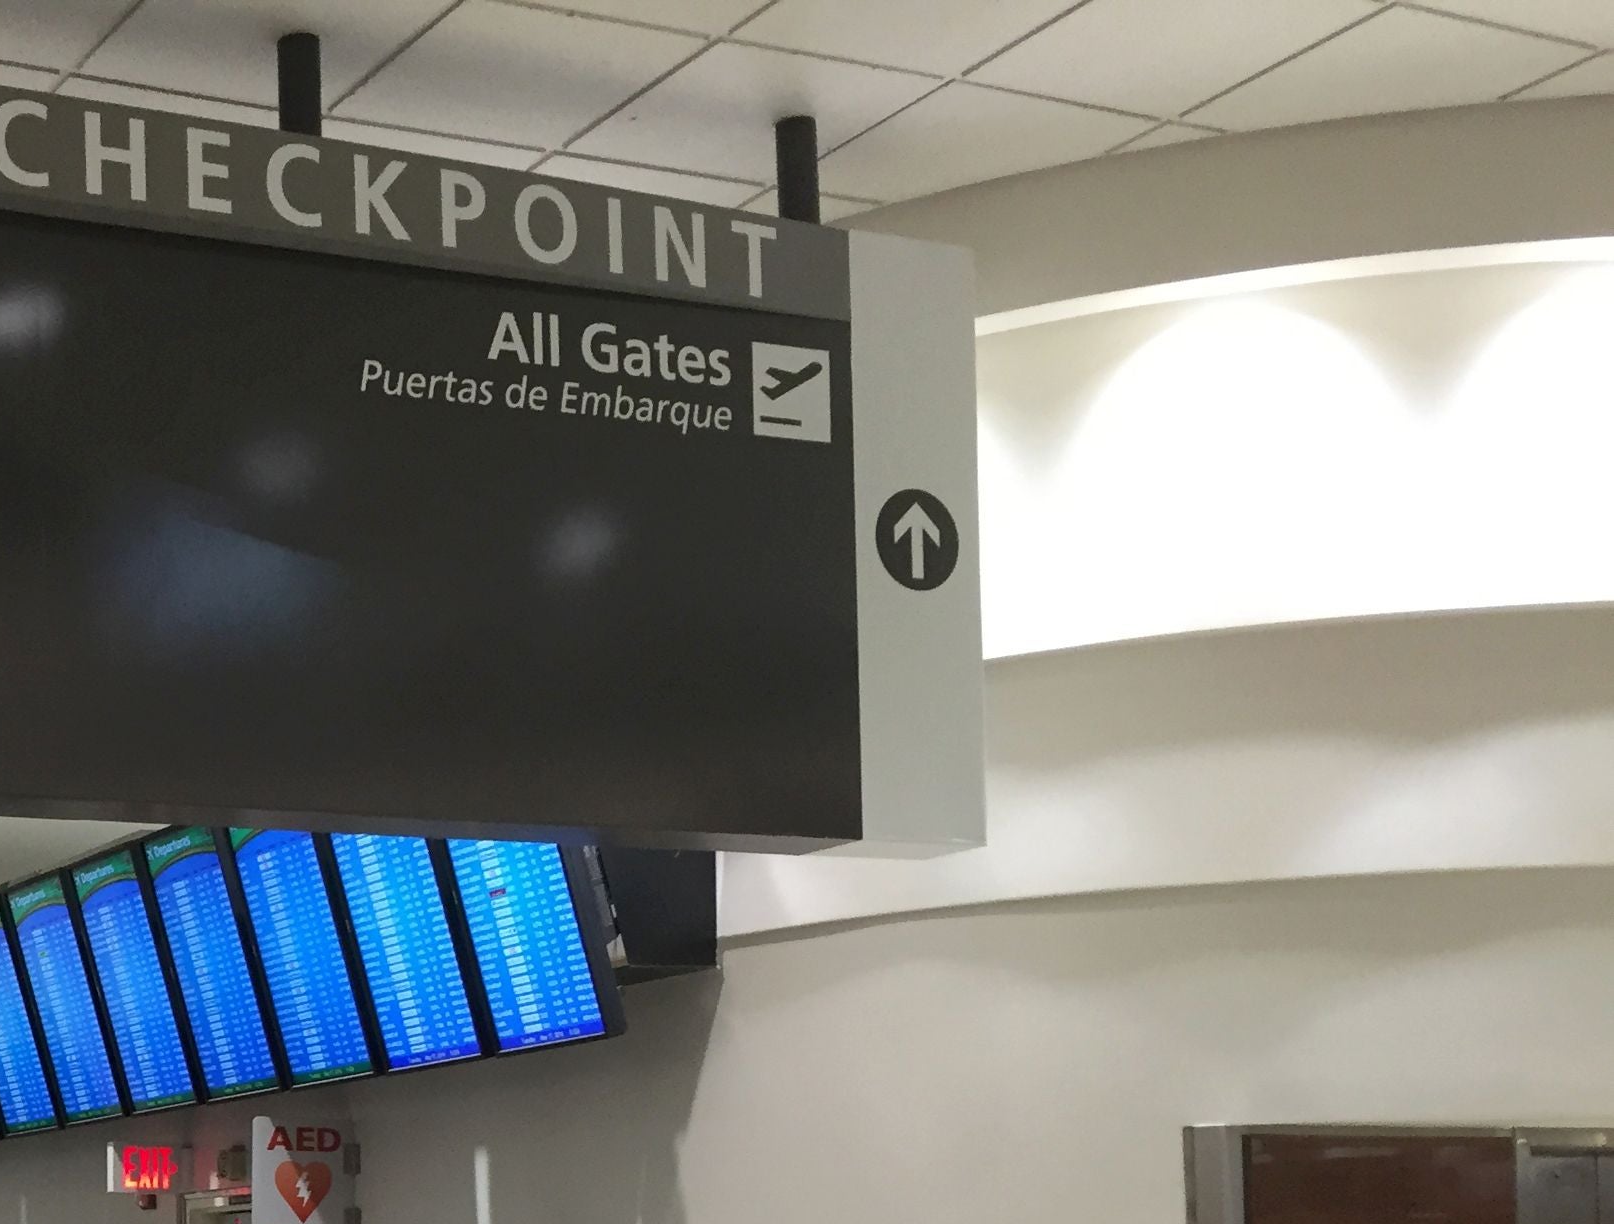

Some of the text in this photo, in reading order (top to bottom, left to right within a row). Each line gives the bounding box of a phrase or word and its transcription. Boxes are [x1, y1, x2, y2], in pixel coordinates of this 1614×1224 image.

[487, 311, 733, 387] All Gates
[359, 359, 734, 435] Puertas de Embarque
[122, 1145, 173, 1190] EXIT
[267, 1125, 341, 1152] AED
